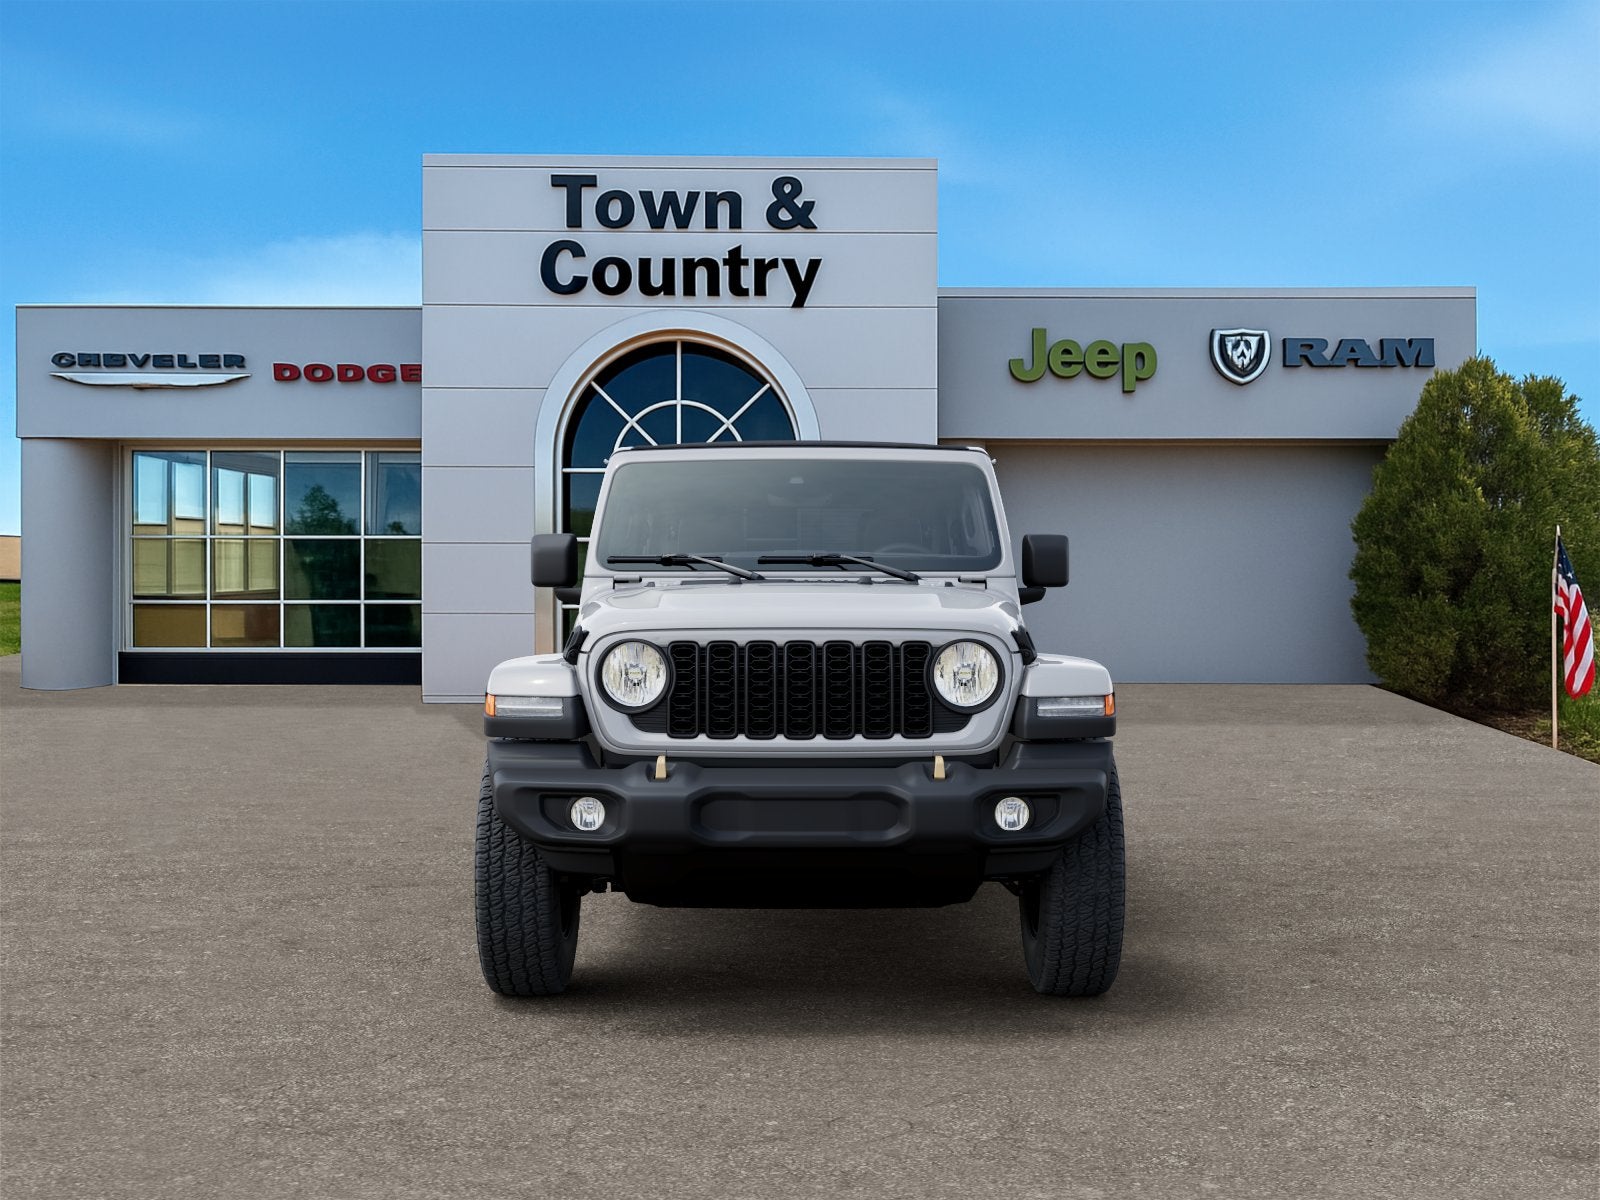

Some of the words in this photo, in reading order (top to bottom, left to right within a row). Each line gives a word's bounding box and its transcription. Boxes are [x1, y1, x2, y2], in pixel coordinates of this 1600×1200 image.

[551, 174, 742, 229] Town
[766, 176, 817, 230] &
[540, 240, 822, 307] Country
[273, 363, 421, 383] DODGE
[1009, 328, 1157, 392] Jeep
[1282, 338, 1434, 367] RAM
